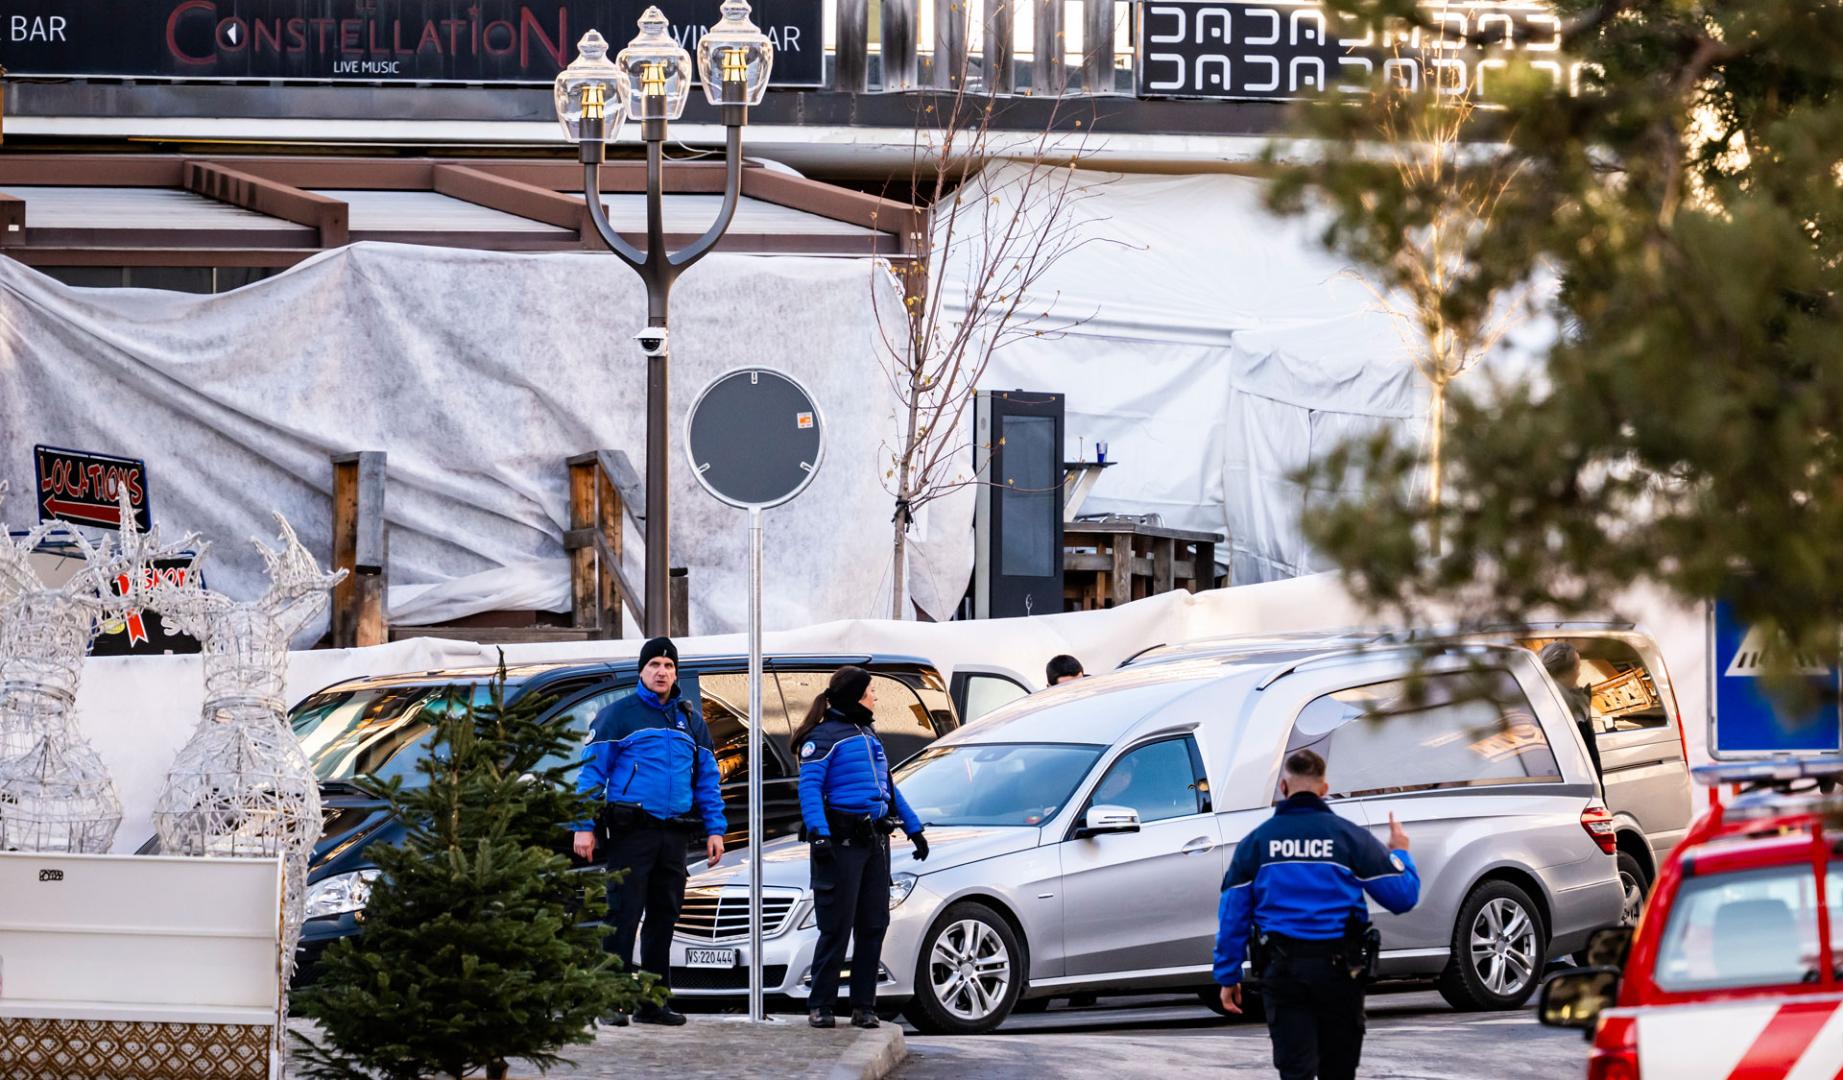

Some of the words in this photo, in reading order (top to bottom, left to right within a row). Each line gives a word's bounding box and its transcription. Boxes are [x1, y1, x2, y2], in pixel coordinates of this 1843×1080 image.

[11, 15, 67, 42] BAR
[333, 60, 360, 73] LIVE
[361, 60, 400, 74] MUSIC
[40, 455, 143, 506] LOCATIONS
[1269, 839, 1334, 858] POLICE
